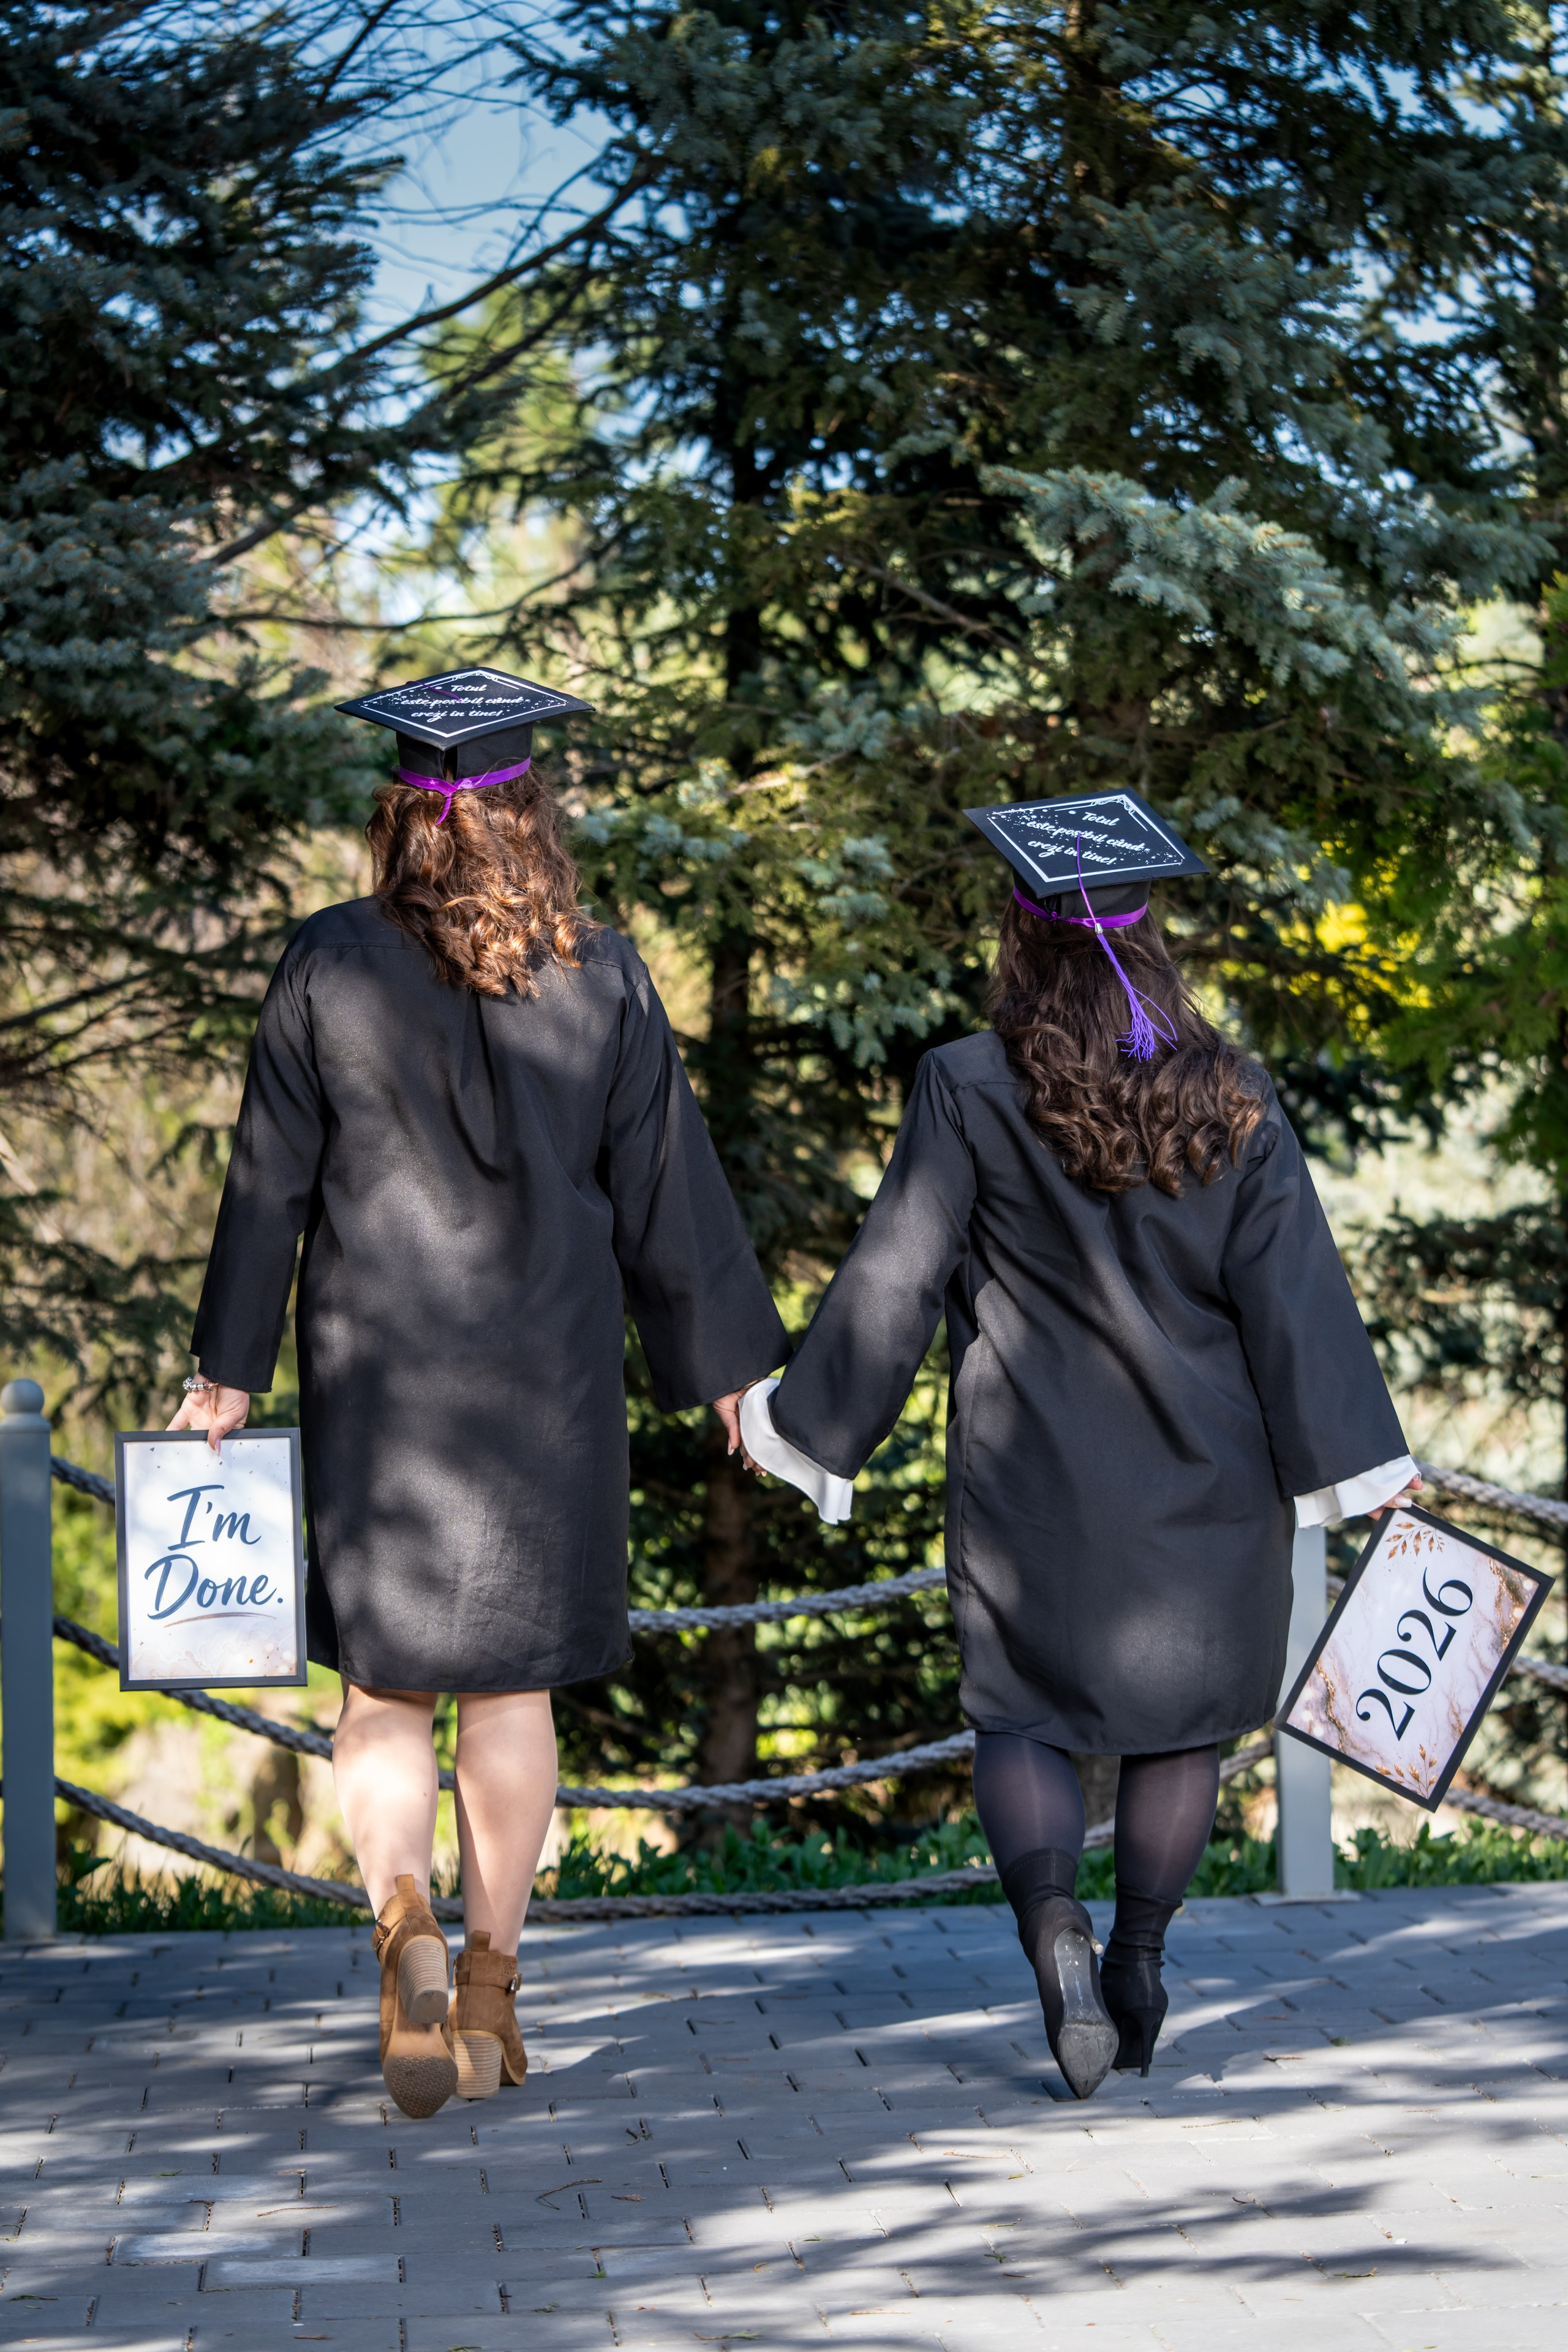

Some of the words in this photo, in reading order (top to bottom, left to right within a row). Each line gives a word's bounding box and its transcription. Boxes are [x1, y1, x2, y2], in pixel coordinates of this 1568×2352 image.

[411, 710, 448, 723] crezi
[1082, 812, 1120, 826] Totul
[1027, 821, 1057, 831] este
[1106, 839, 1145, 851] când
[1028, 841, 1065, 858] crezi
[1082, 851, 1117, 865] tine!
[167, 1485, 262, 1551] I'm
[144, 1554, 284, 1620] Done.
[1355, 1566, 1474, 1741] 2026
